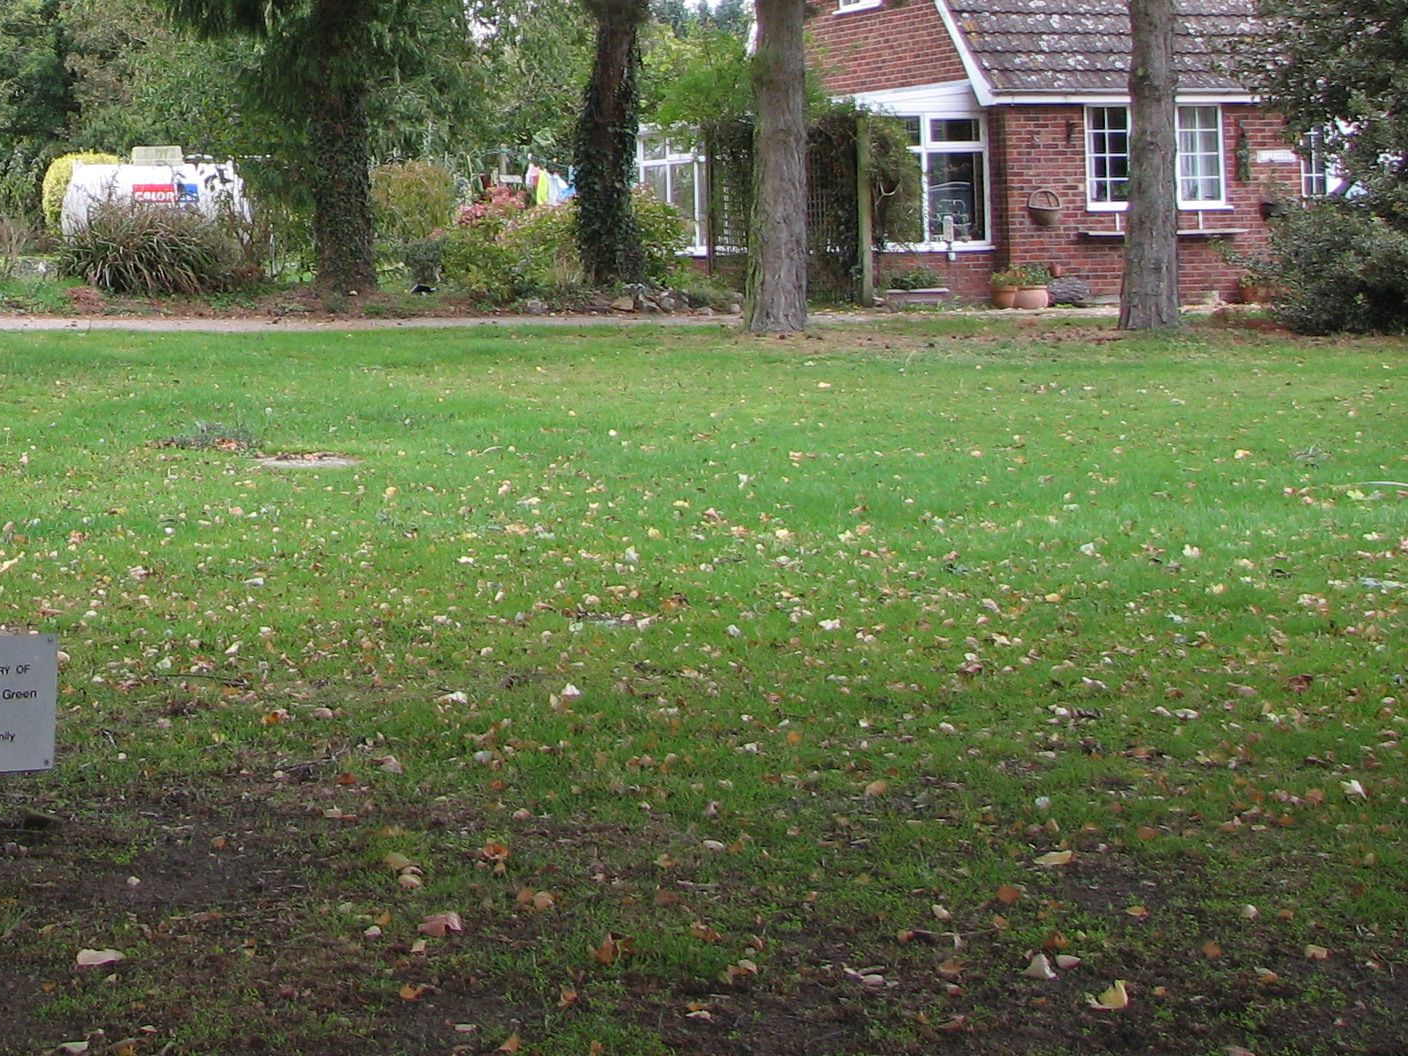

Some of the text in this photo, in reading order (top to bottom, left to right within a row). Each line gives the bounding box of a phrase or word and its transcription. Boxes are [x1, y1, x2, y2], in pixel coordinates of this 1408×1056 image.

[134, 191, 175, 201] CALOR
[16, 664, 30, 674] OF
[2, 689, 37, 699] Green
